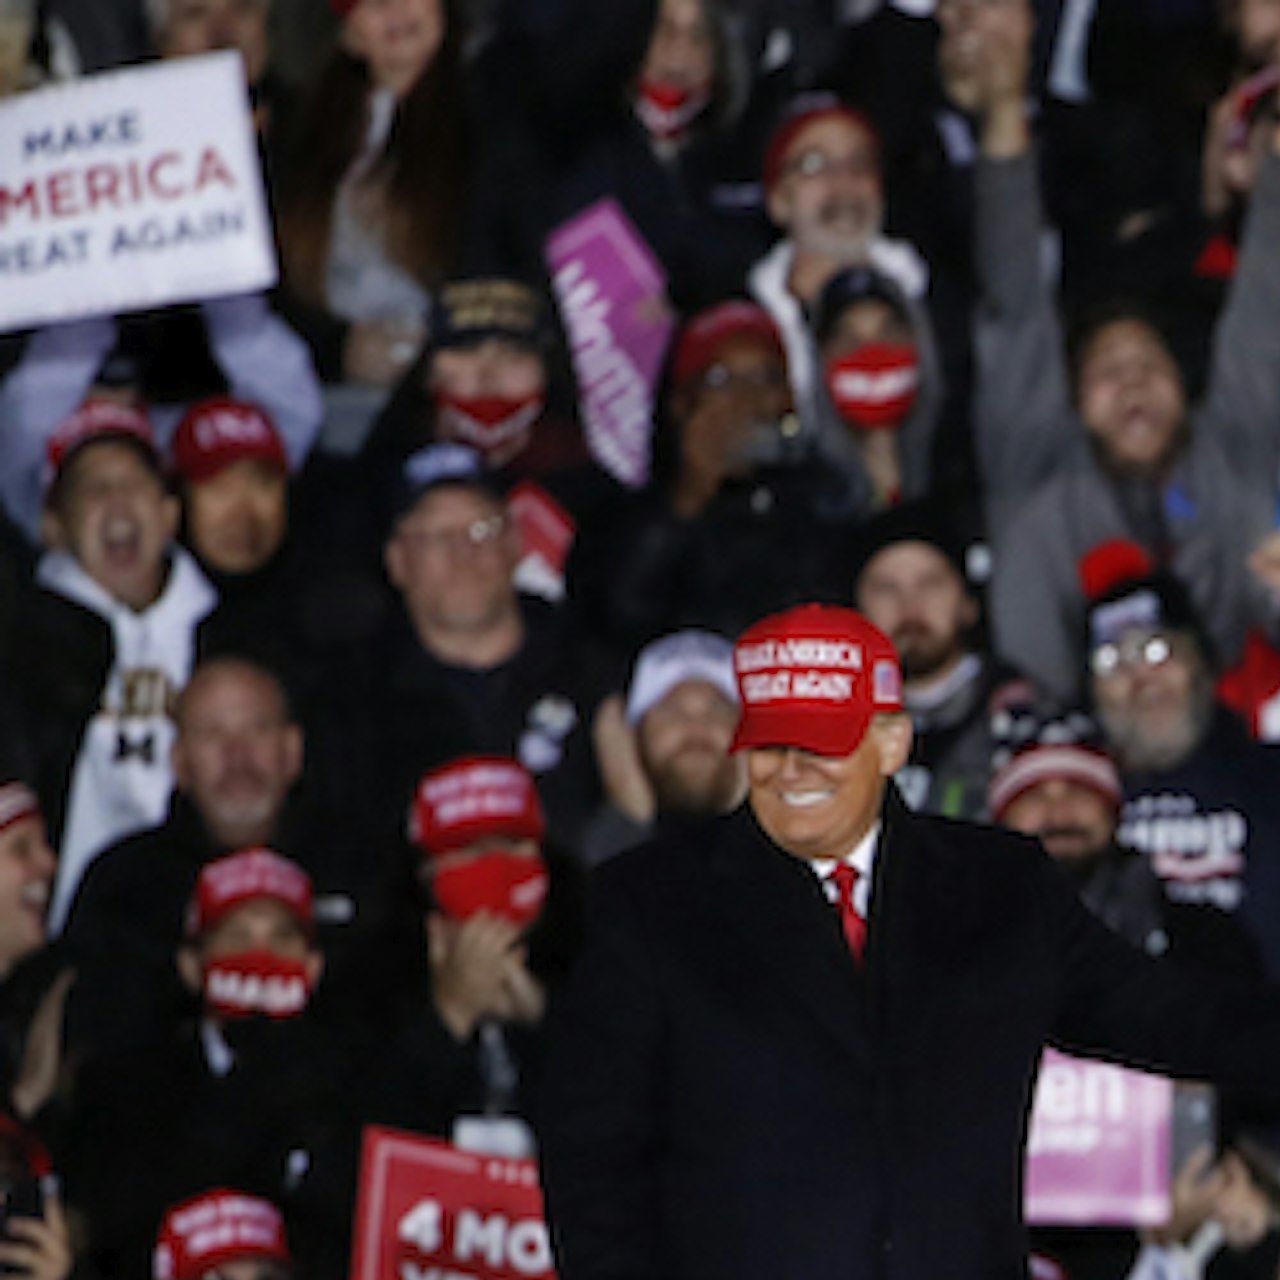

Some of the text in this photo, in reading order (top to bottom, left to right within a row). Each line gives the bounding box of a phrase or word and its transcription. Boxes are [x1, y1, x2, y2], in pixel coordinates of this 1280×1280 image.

[23, 109, 140, 158] MAKE
[109, 208, 247, 258] AGAIN
[398, 1197, 442, 1252] 4
